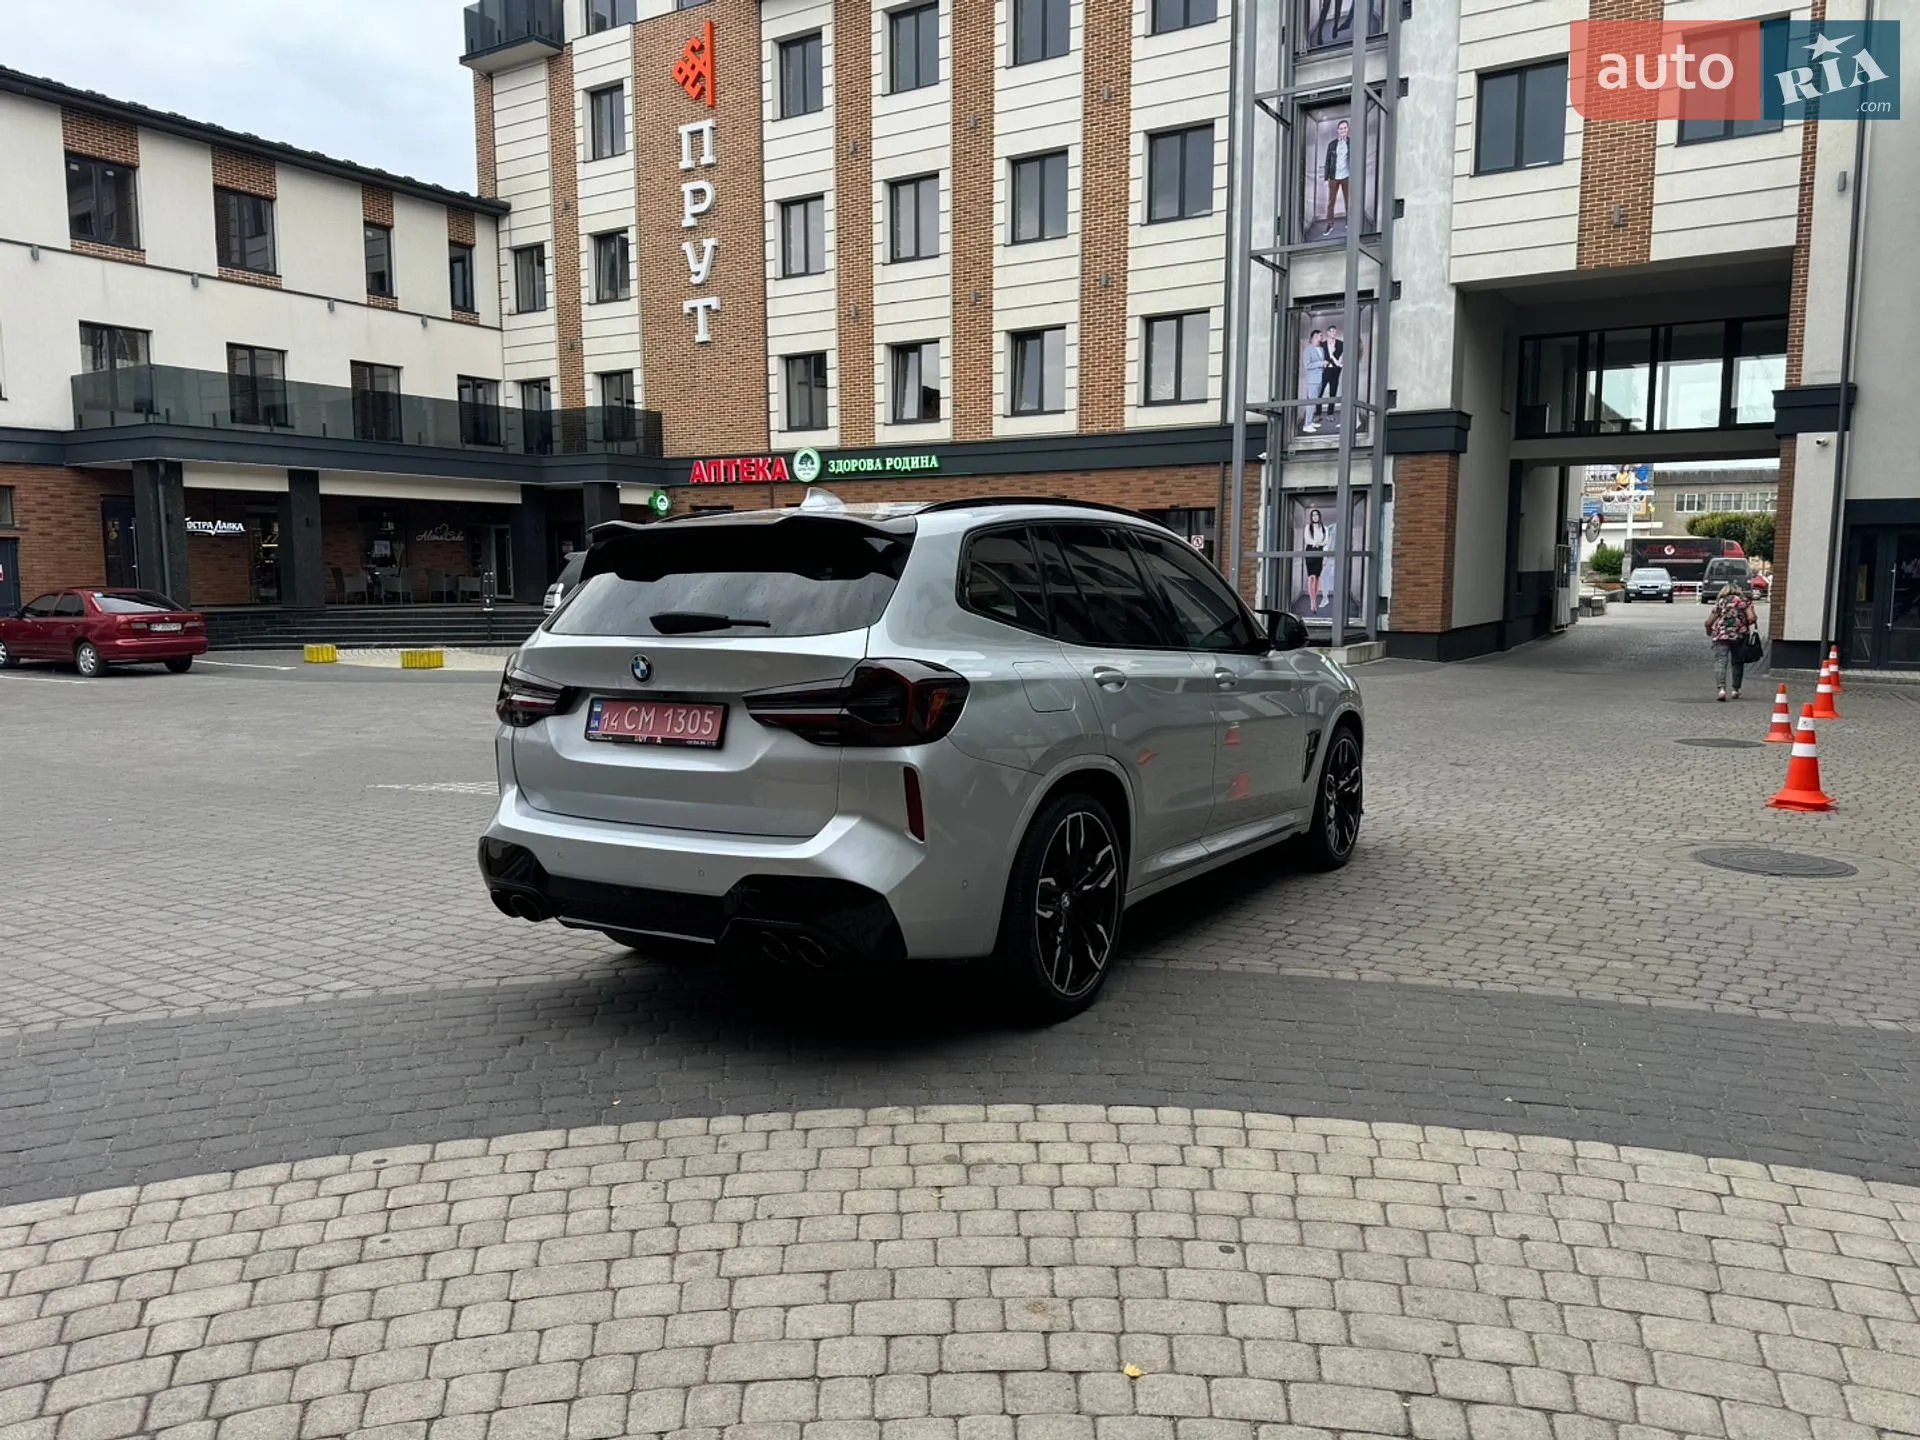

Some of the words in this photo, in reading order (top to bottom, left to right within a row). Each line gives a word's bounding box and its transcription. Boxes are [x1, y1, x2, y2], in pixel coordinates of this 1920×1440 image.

[678, 118, 721, 344] ПРУТ
[689, 457, 790, 484] АПТЕКА
[828, 457, 882, 474] ЗДОРОВА
[885, 454, 940, 470] РОДИНА
[602, 711, 621, 731] 14
[624, 706, 656, 732] CM
[664, 708, 714, 735] 1305
